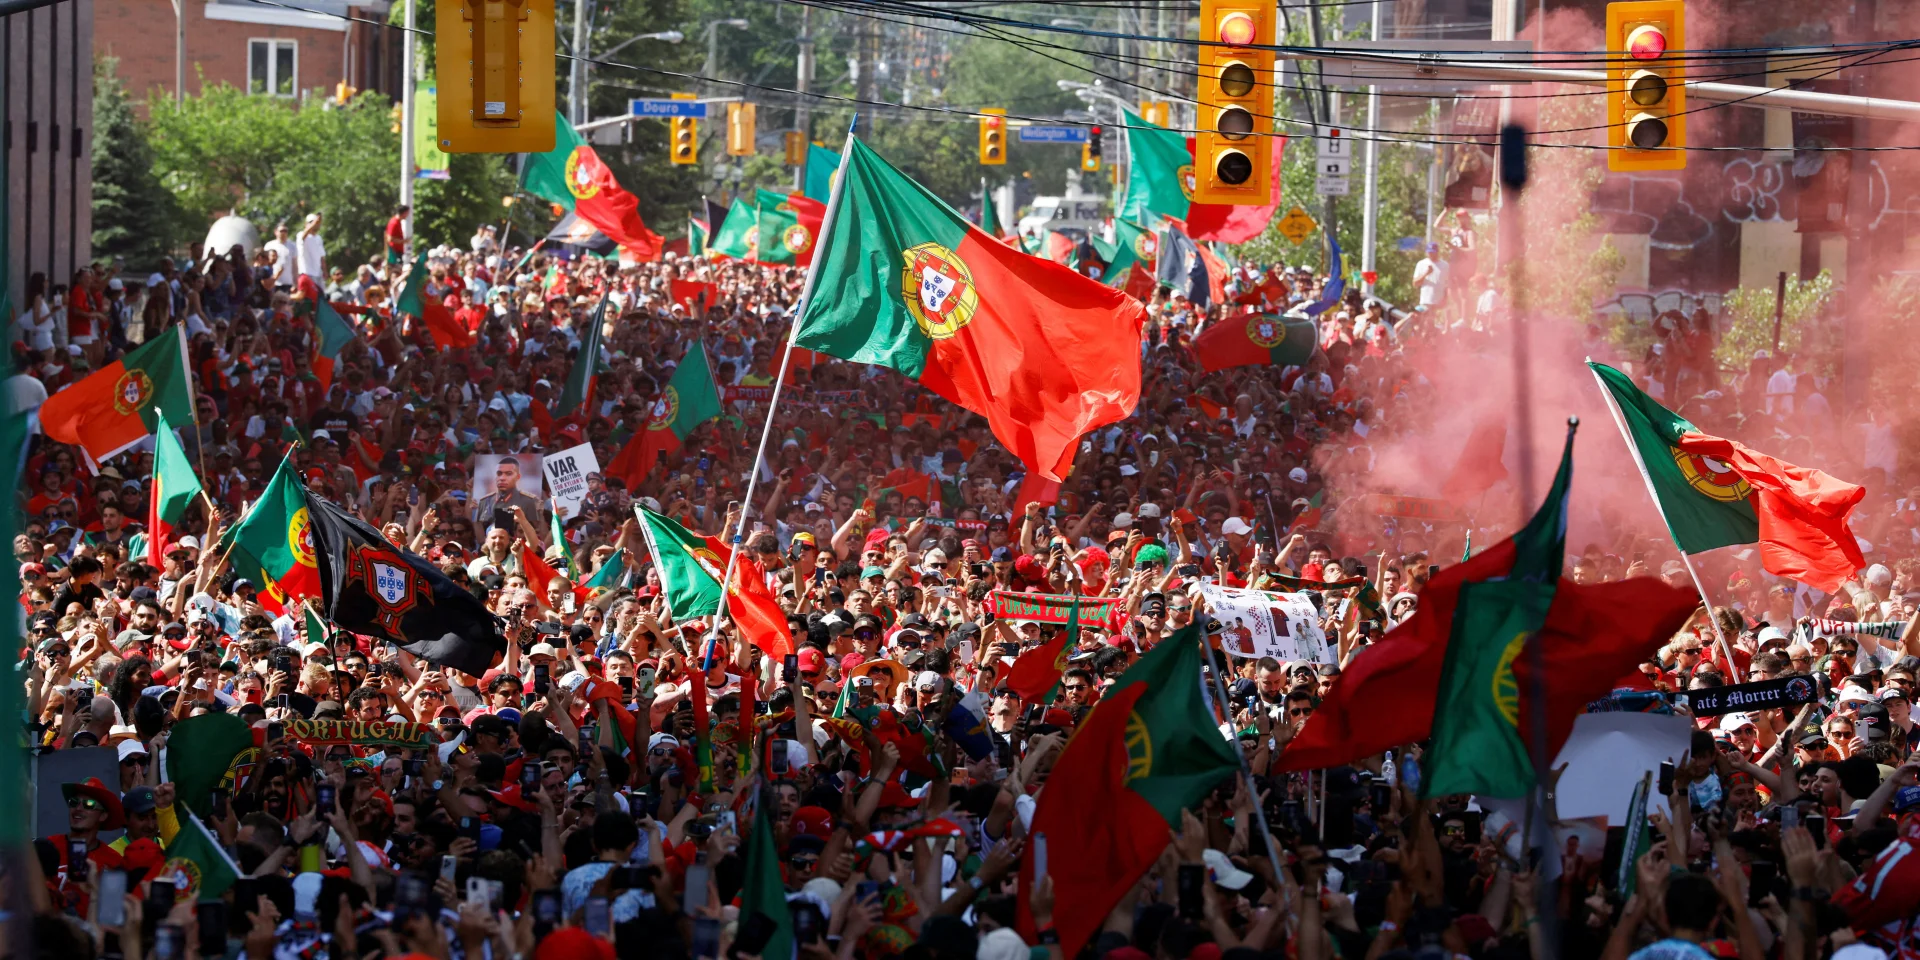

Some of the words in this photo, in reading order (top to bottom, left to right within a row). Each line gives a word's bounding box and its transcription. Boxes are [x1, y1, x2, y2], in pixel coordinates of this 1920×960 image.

[643, 102, 679, 113] Douro
[1022, 129, 1067, 140] Wellington
[547, 456, 578, 478] VAR
[559, 471, 582, 483] WAITING
[994, 592, 1040, 615] FORÇA
[1044, 597, 1117, 625] PORUGAL
[1697, 693, 1718, 710] até
[1726, 689, 1780, 708] Morrer
[282, 718, 424, 743] PORTUGAL
